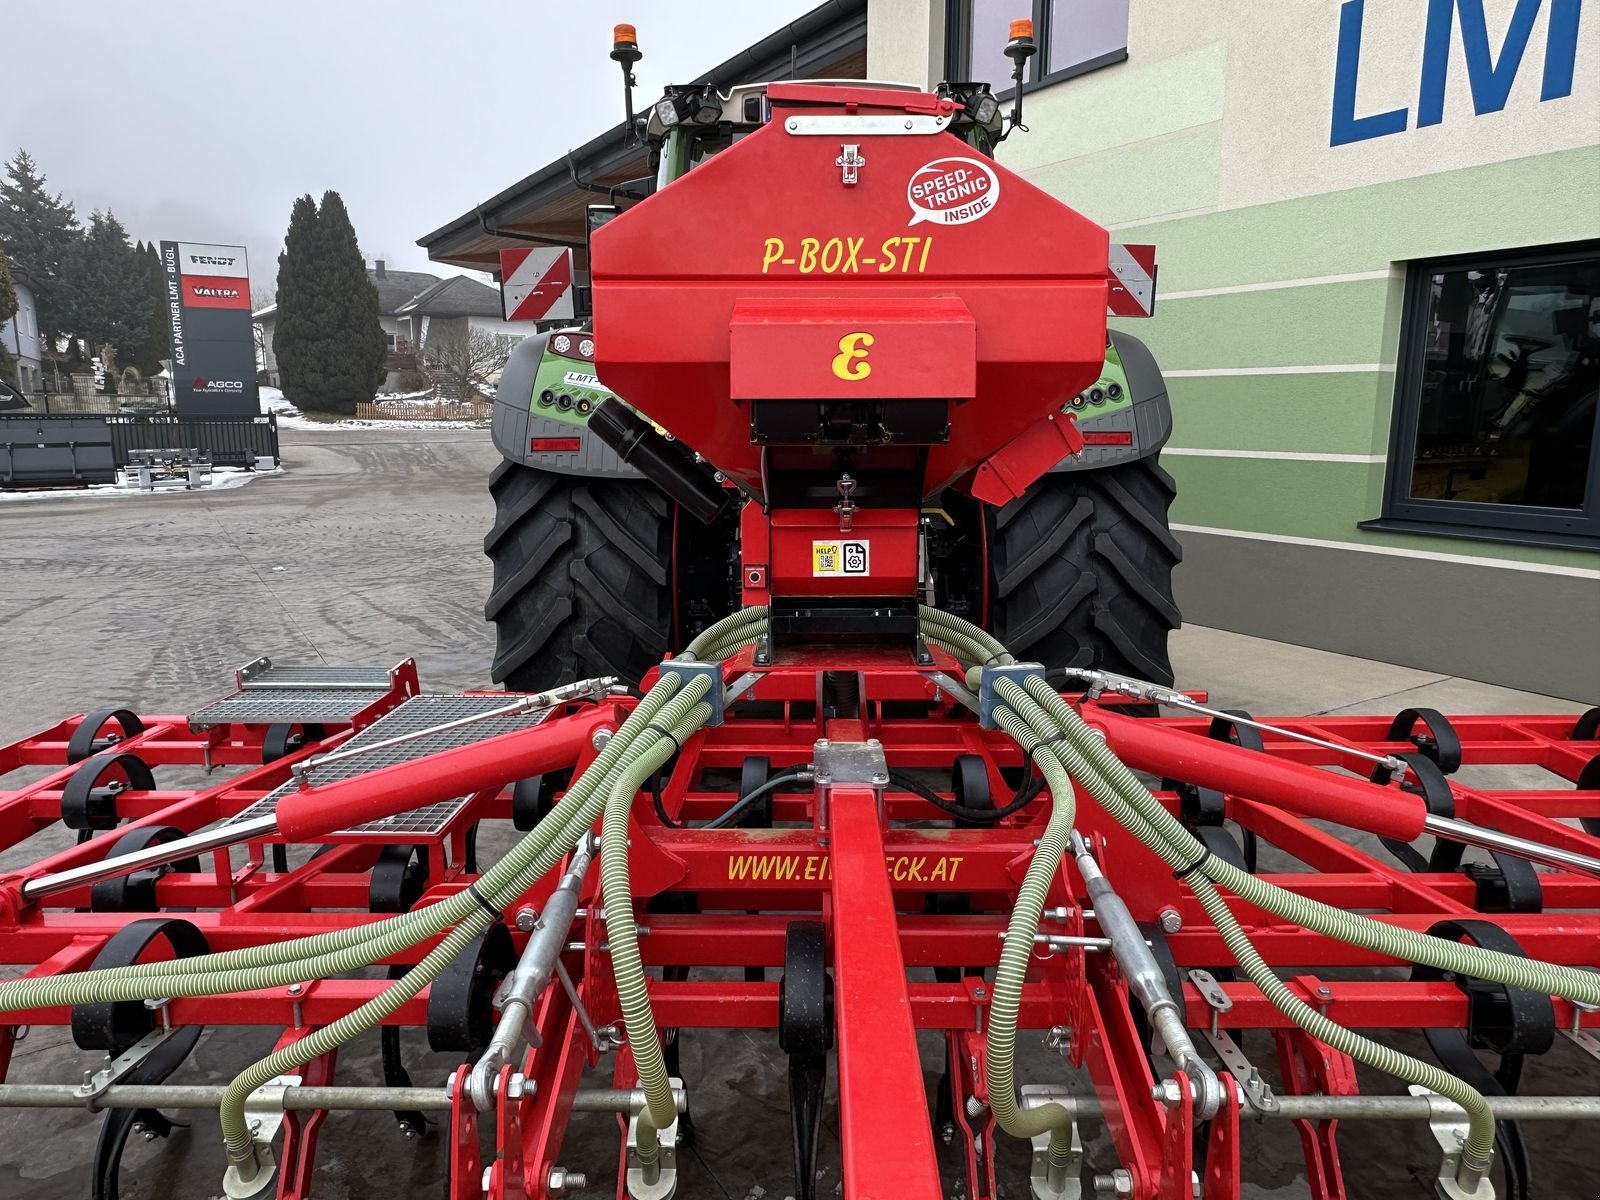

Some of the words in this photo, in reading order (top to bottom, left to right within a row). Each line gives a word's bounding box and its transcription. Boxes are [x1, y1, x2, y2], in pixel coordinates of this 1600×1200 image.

[1330, 0, 1582, 147] LM
[912, 169, 972, 198] SPEED-
[924, 176, 988, 208] TRONIC
[944, 196, 992, 222] INSIDE
[165, 247, 176, 273] BUGL
[190, 255, 236, 266] FENDT
[762, 236, 933, 274] P-BOX-STI
[168, 280, 179, 300] LMT
[192, 287, 240, 298] VALTRA
[170, 301, 183, 344] PARTNER
[176, 346, 185, 365] ACA
[207, 380, 243, 388] AGCO
[816, 547, 832, 555] HELP
[728, 856, 963, 882] WWW.EICK.AT
